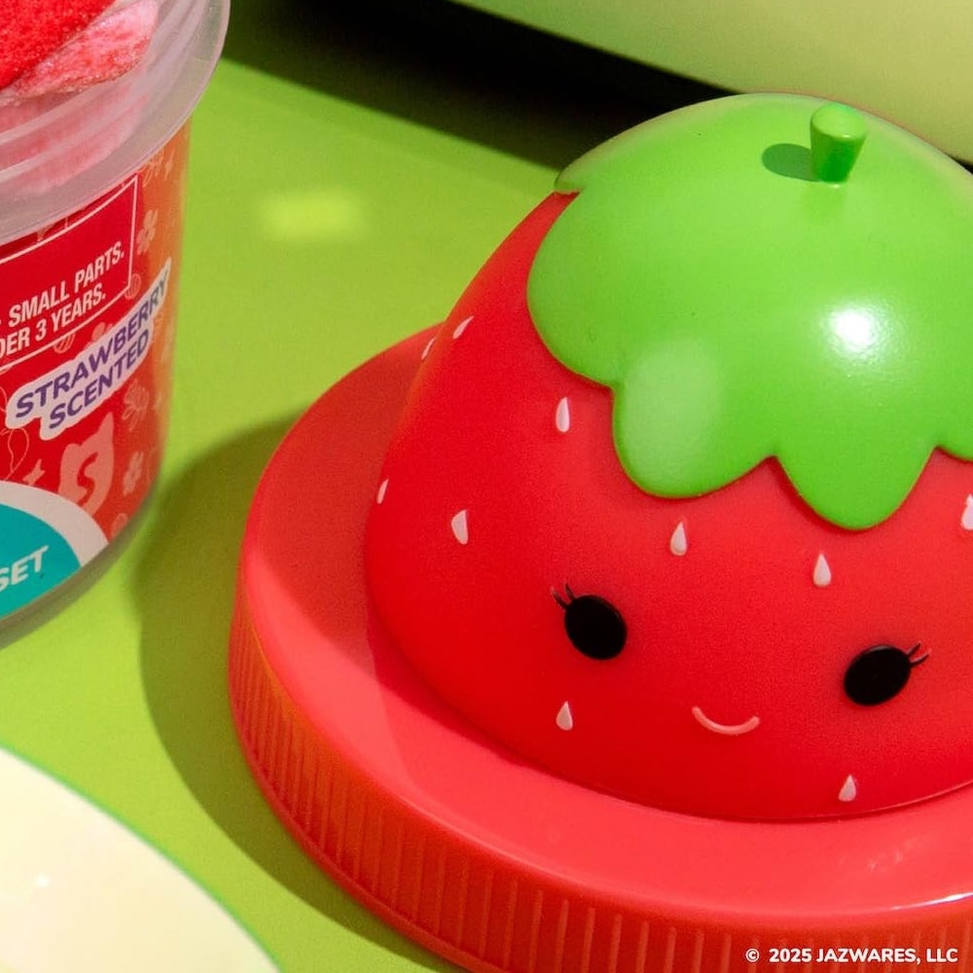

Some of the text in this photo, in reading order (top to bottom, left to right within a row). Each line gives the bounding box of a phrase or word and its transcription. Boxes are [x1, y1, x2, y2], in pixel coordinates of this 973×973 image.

[8, 280, 70, 328] SMALL
[74, 240, 125, 294] PARTS.
[35, 318, 48, 342] 3
[51, 282, 107, 333] YEARS.
[15, 267, 170, 419] STRAWBERRY
[49, 329, 149, 430] SCENTED
